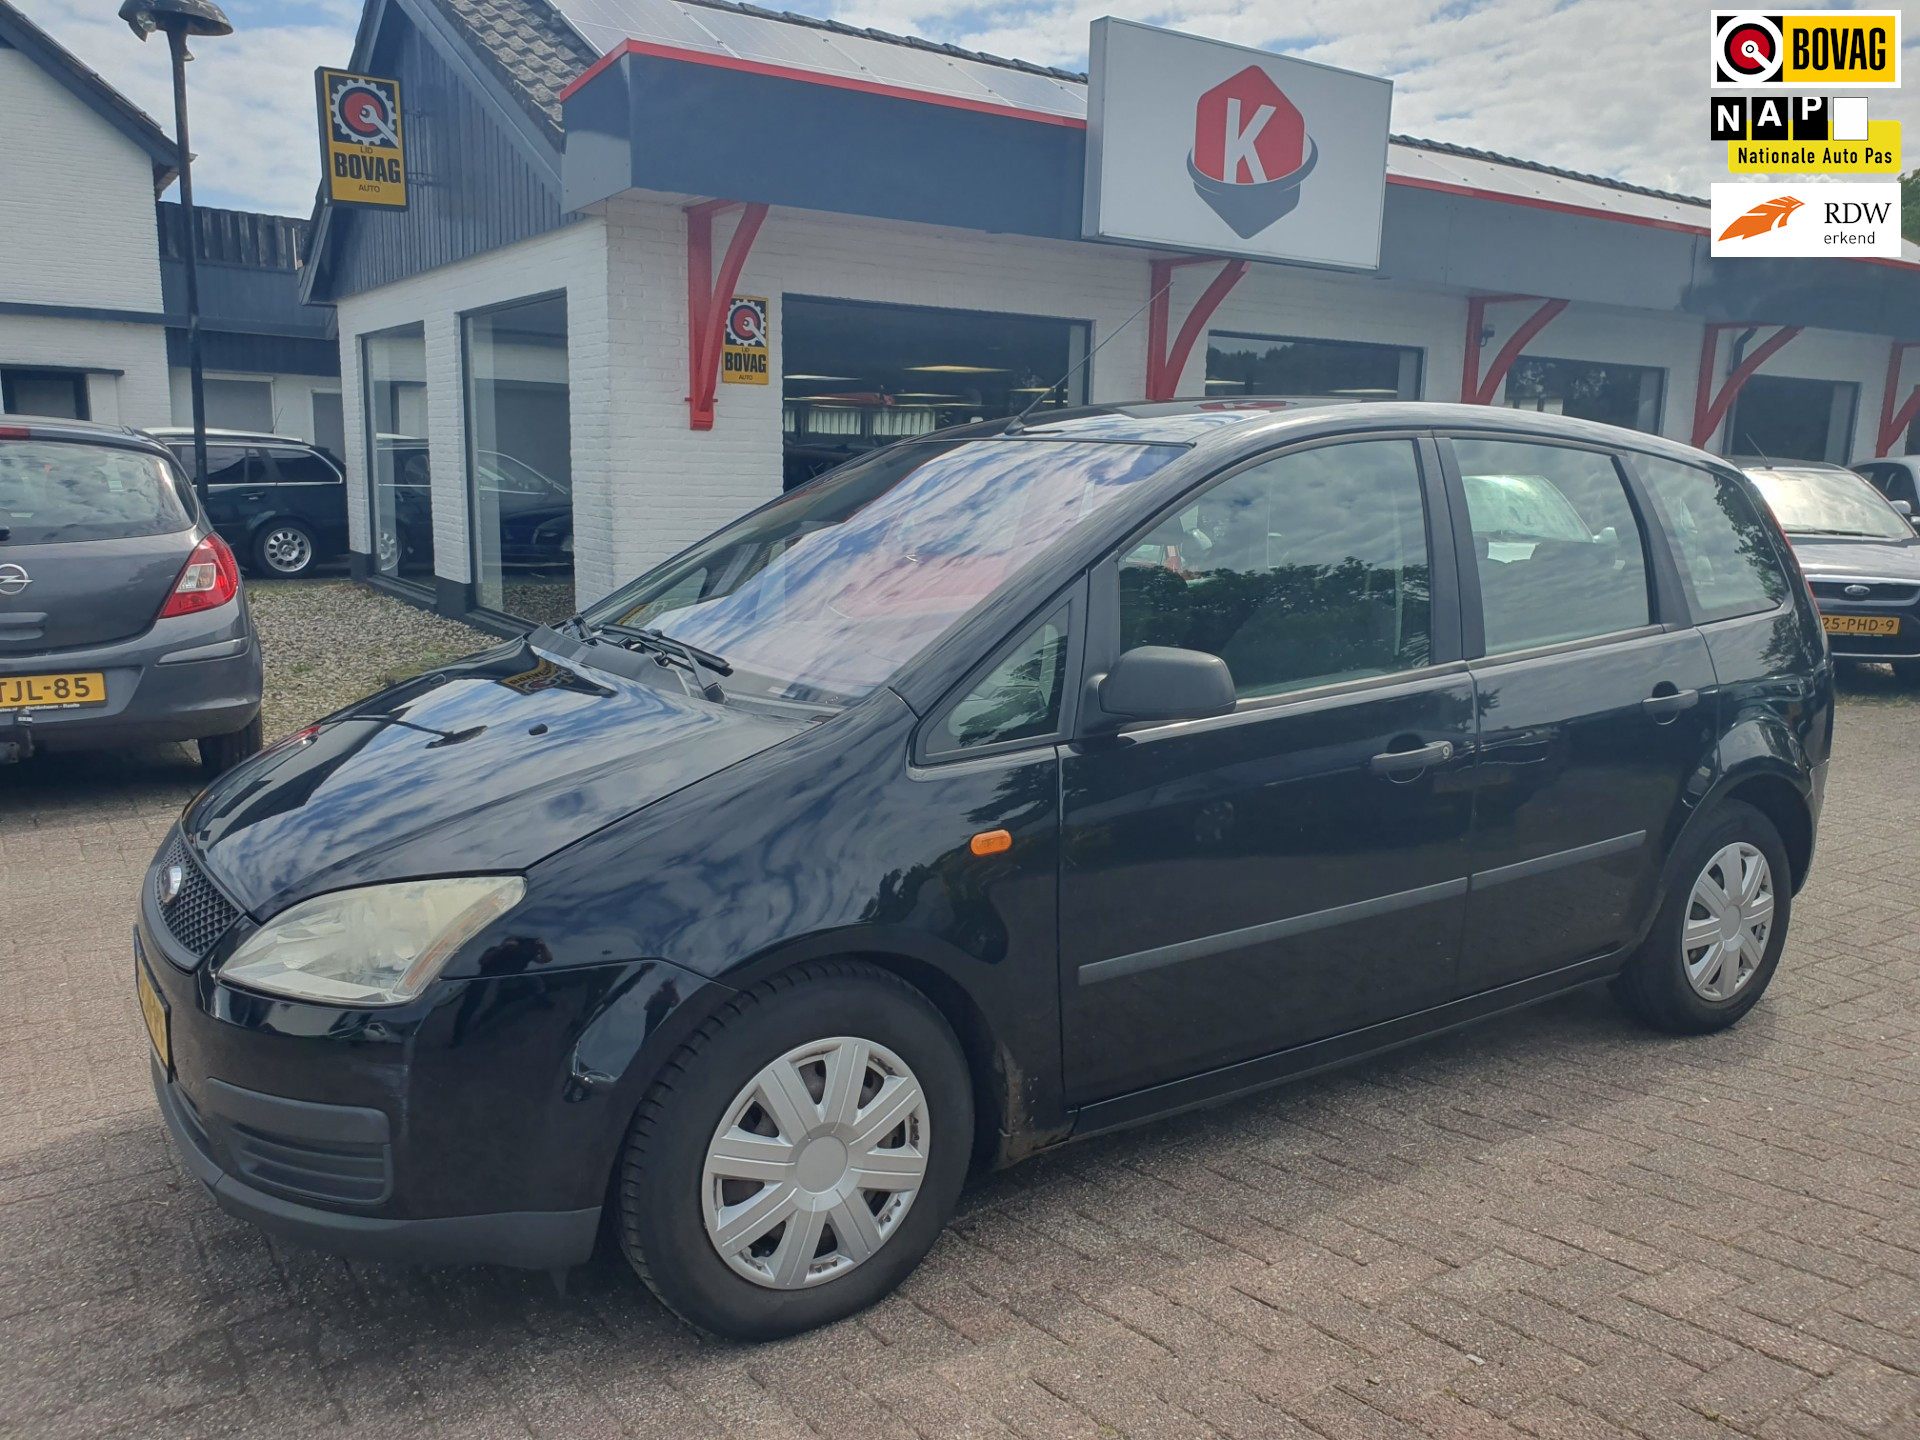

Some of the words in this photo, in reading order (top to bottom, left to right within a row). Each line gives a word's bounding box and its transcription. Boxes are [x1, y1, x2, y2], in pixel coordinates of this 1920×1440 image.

[360, 146, 374, 154] LID
[1223, 97, 1277, 185] K
[334, 152, 401, 184] BOVAG
[358, 184, 381, 193] AUTO
[725, 352, 767, 373] BOVAG
[1822, 617, 1895, 632] 25-PHD-9
